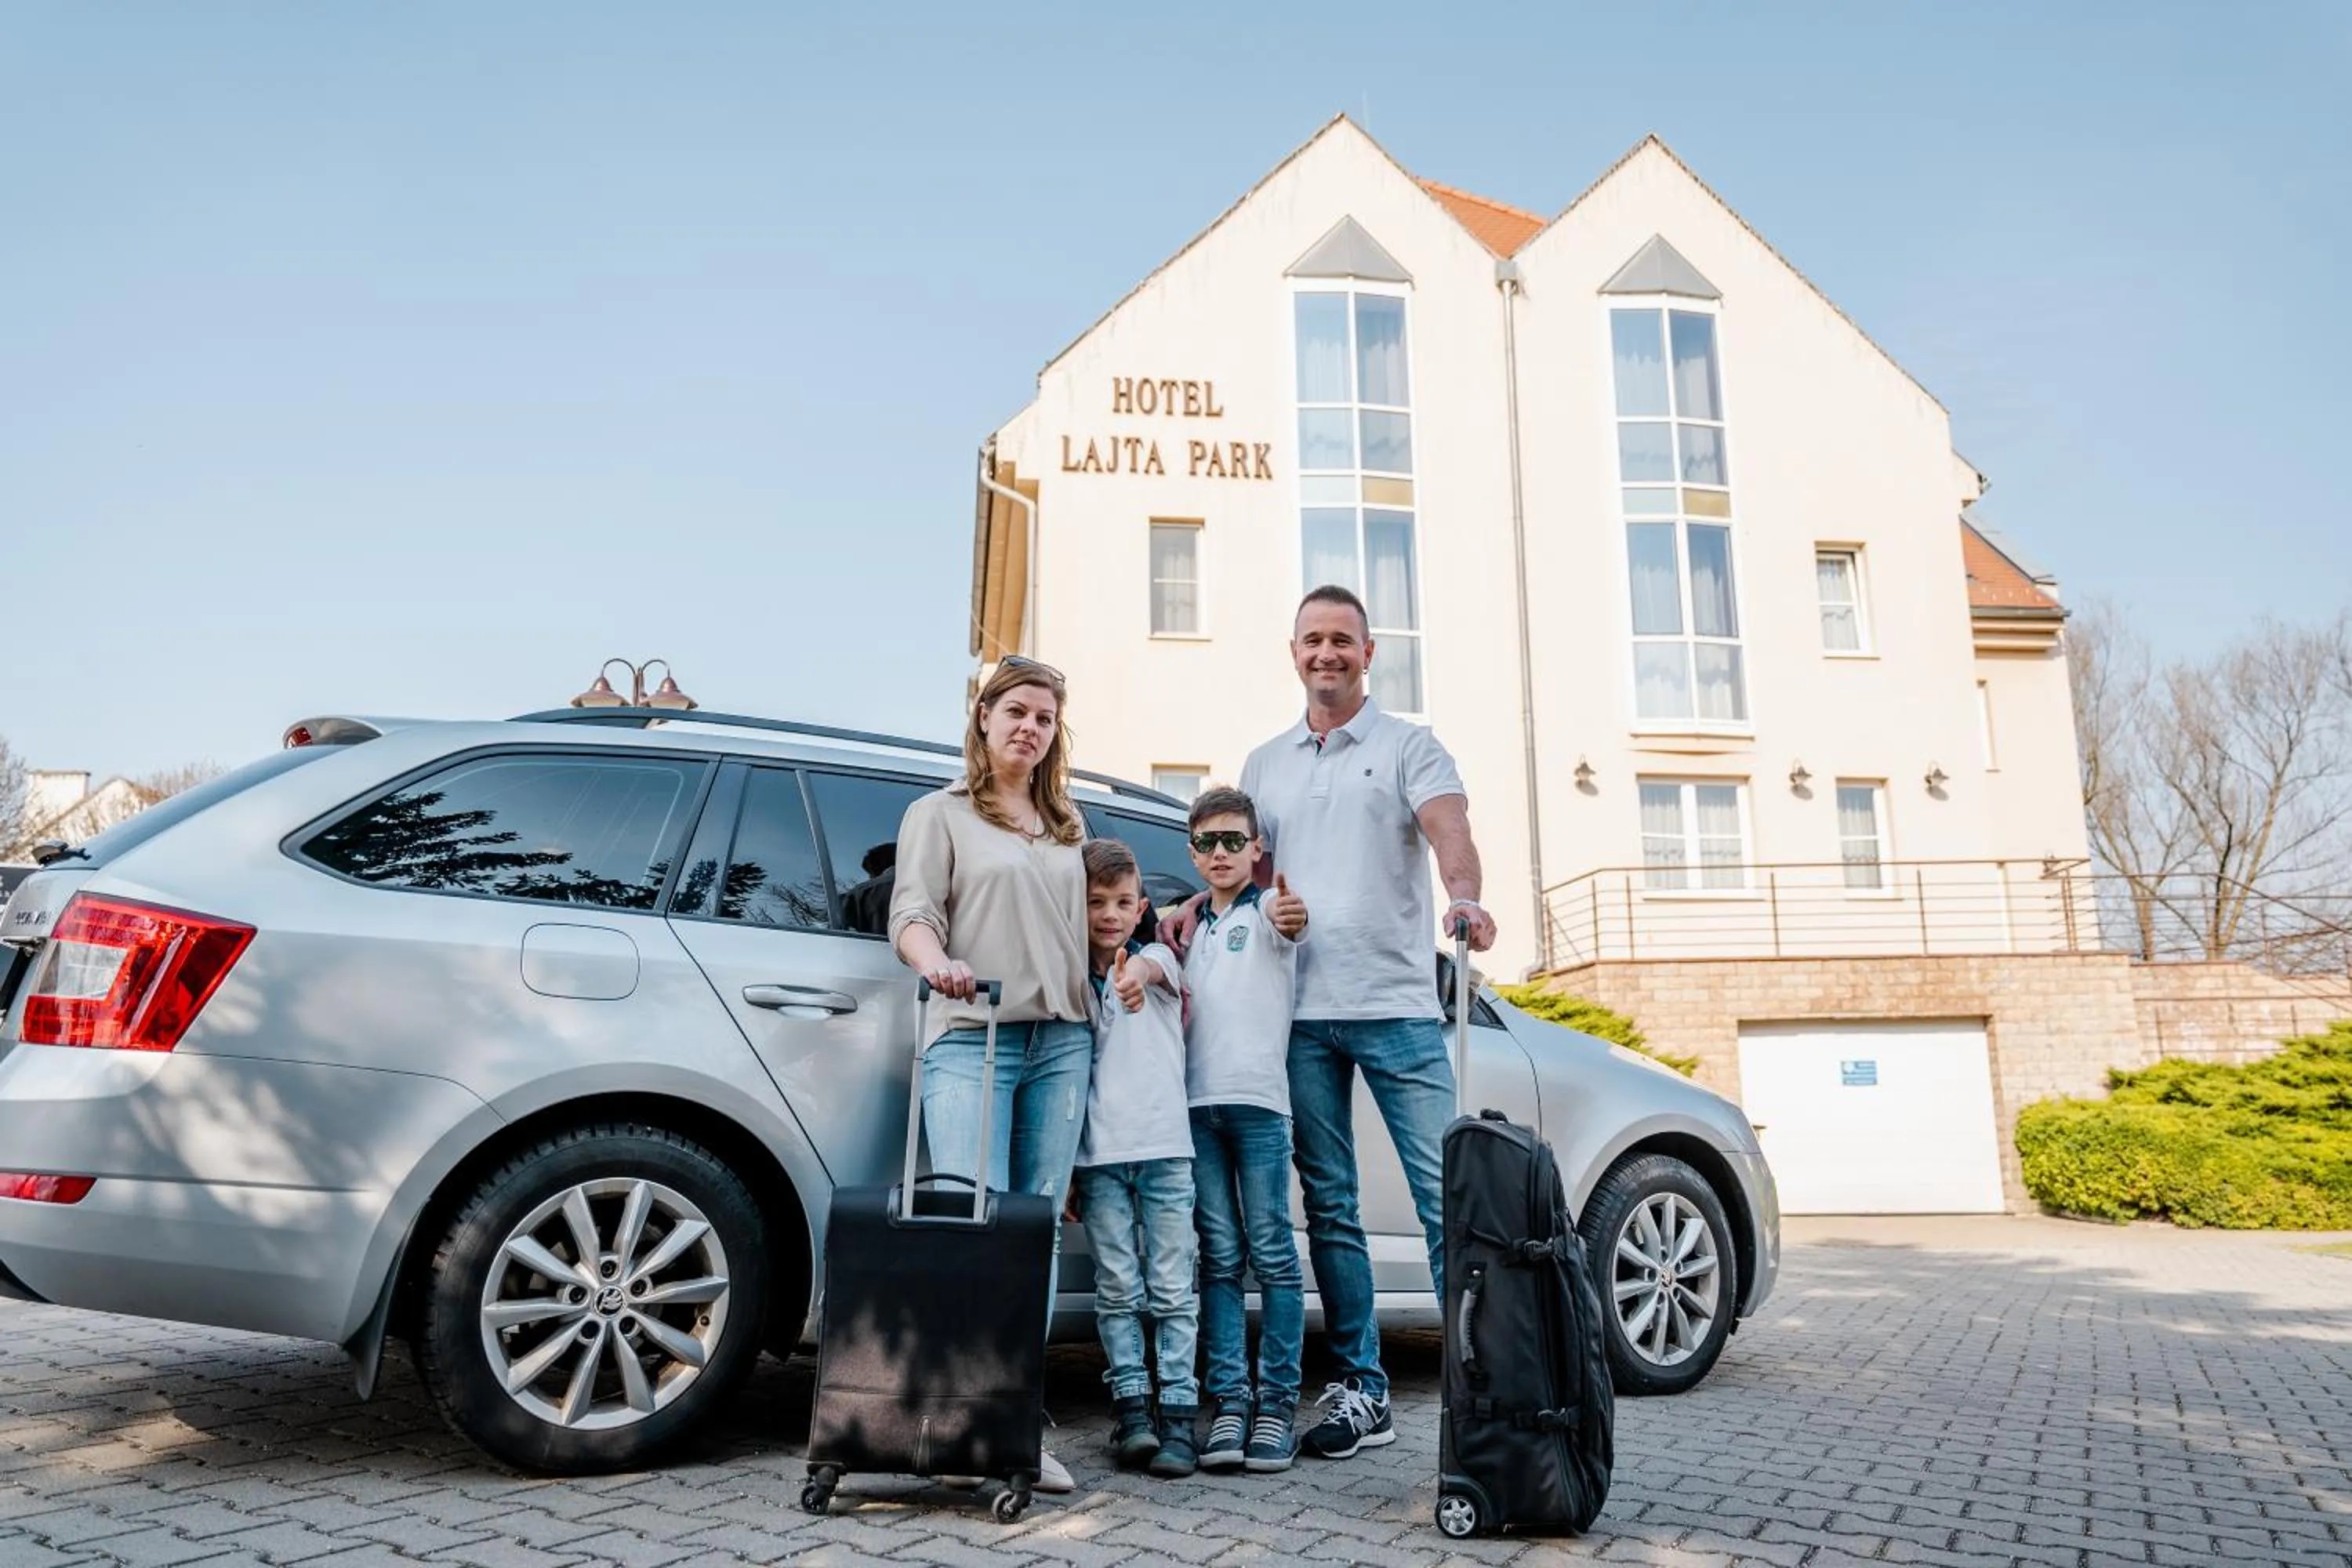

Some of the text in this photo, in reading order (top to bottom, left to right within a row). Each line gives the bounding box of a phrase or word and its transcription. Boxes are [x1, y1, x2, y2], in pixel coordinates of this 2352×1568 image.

[1112, 376, 1224, 418] HOTEL
[1061, 435, 1273, 481] LAJTA PARK
